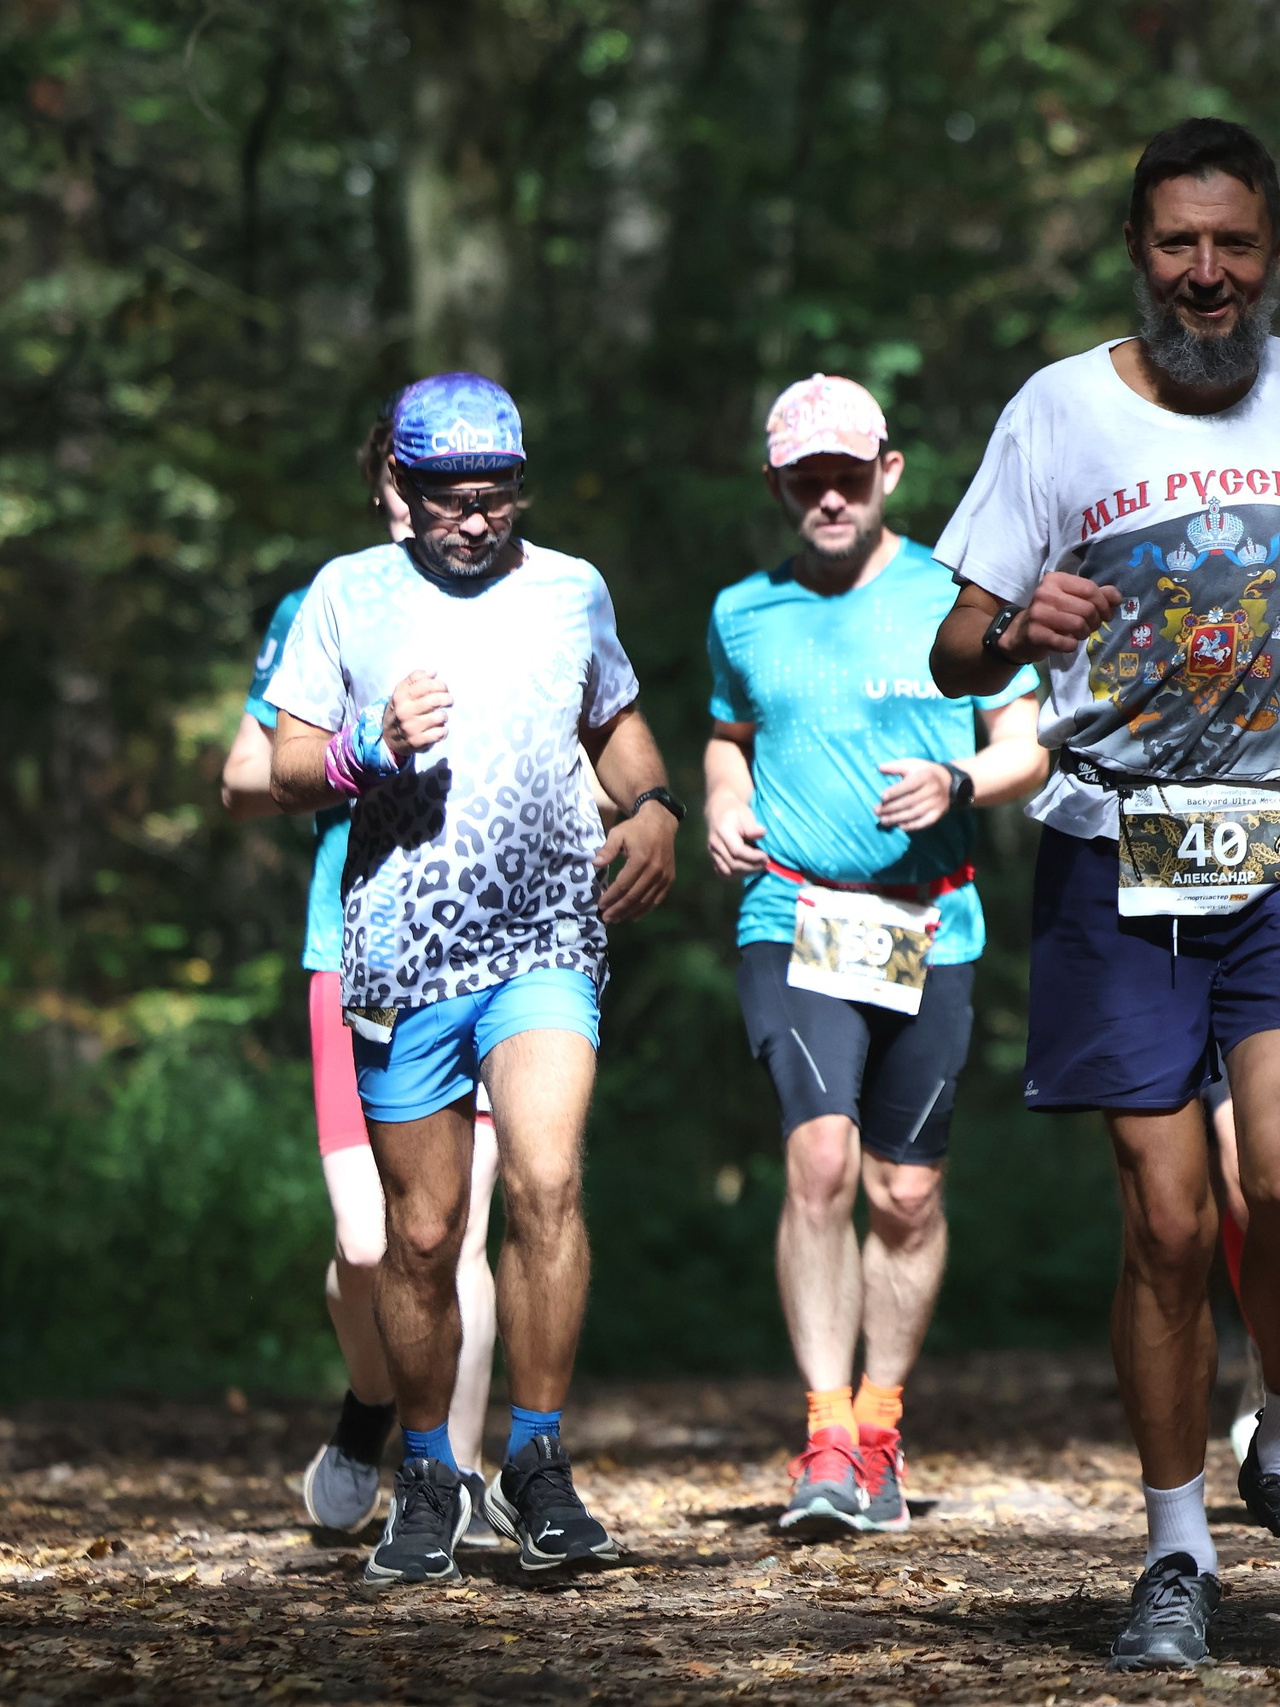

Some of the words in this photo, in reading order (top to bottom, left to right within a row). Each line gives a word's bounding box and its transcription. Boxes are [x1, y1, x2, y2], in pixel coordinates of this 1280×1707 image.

[1081, 481, 1149, 541] МЫ
[865, 679, 887, 699] U
[1187, 797, 1228, 806] Backyard
[1232, 797, 1256, 805] Ultra
[1177, 821, 1248, 867] 40
